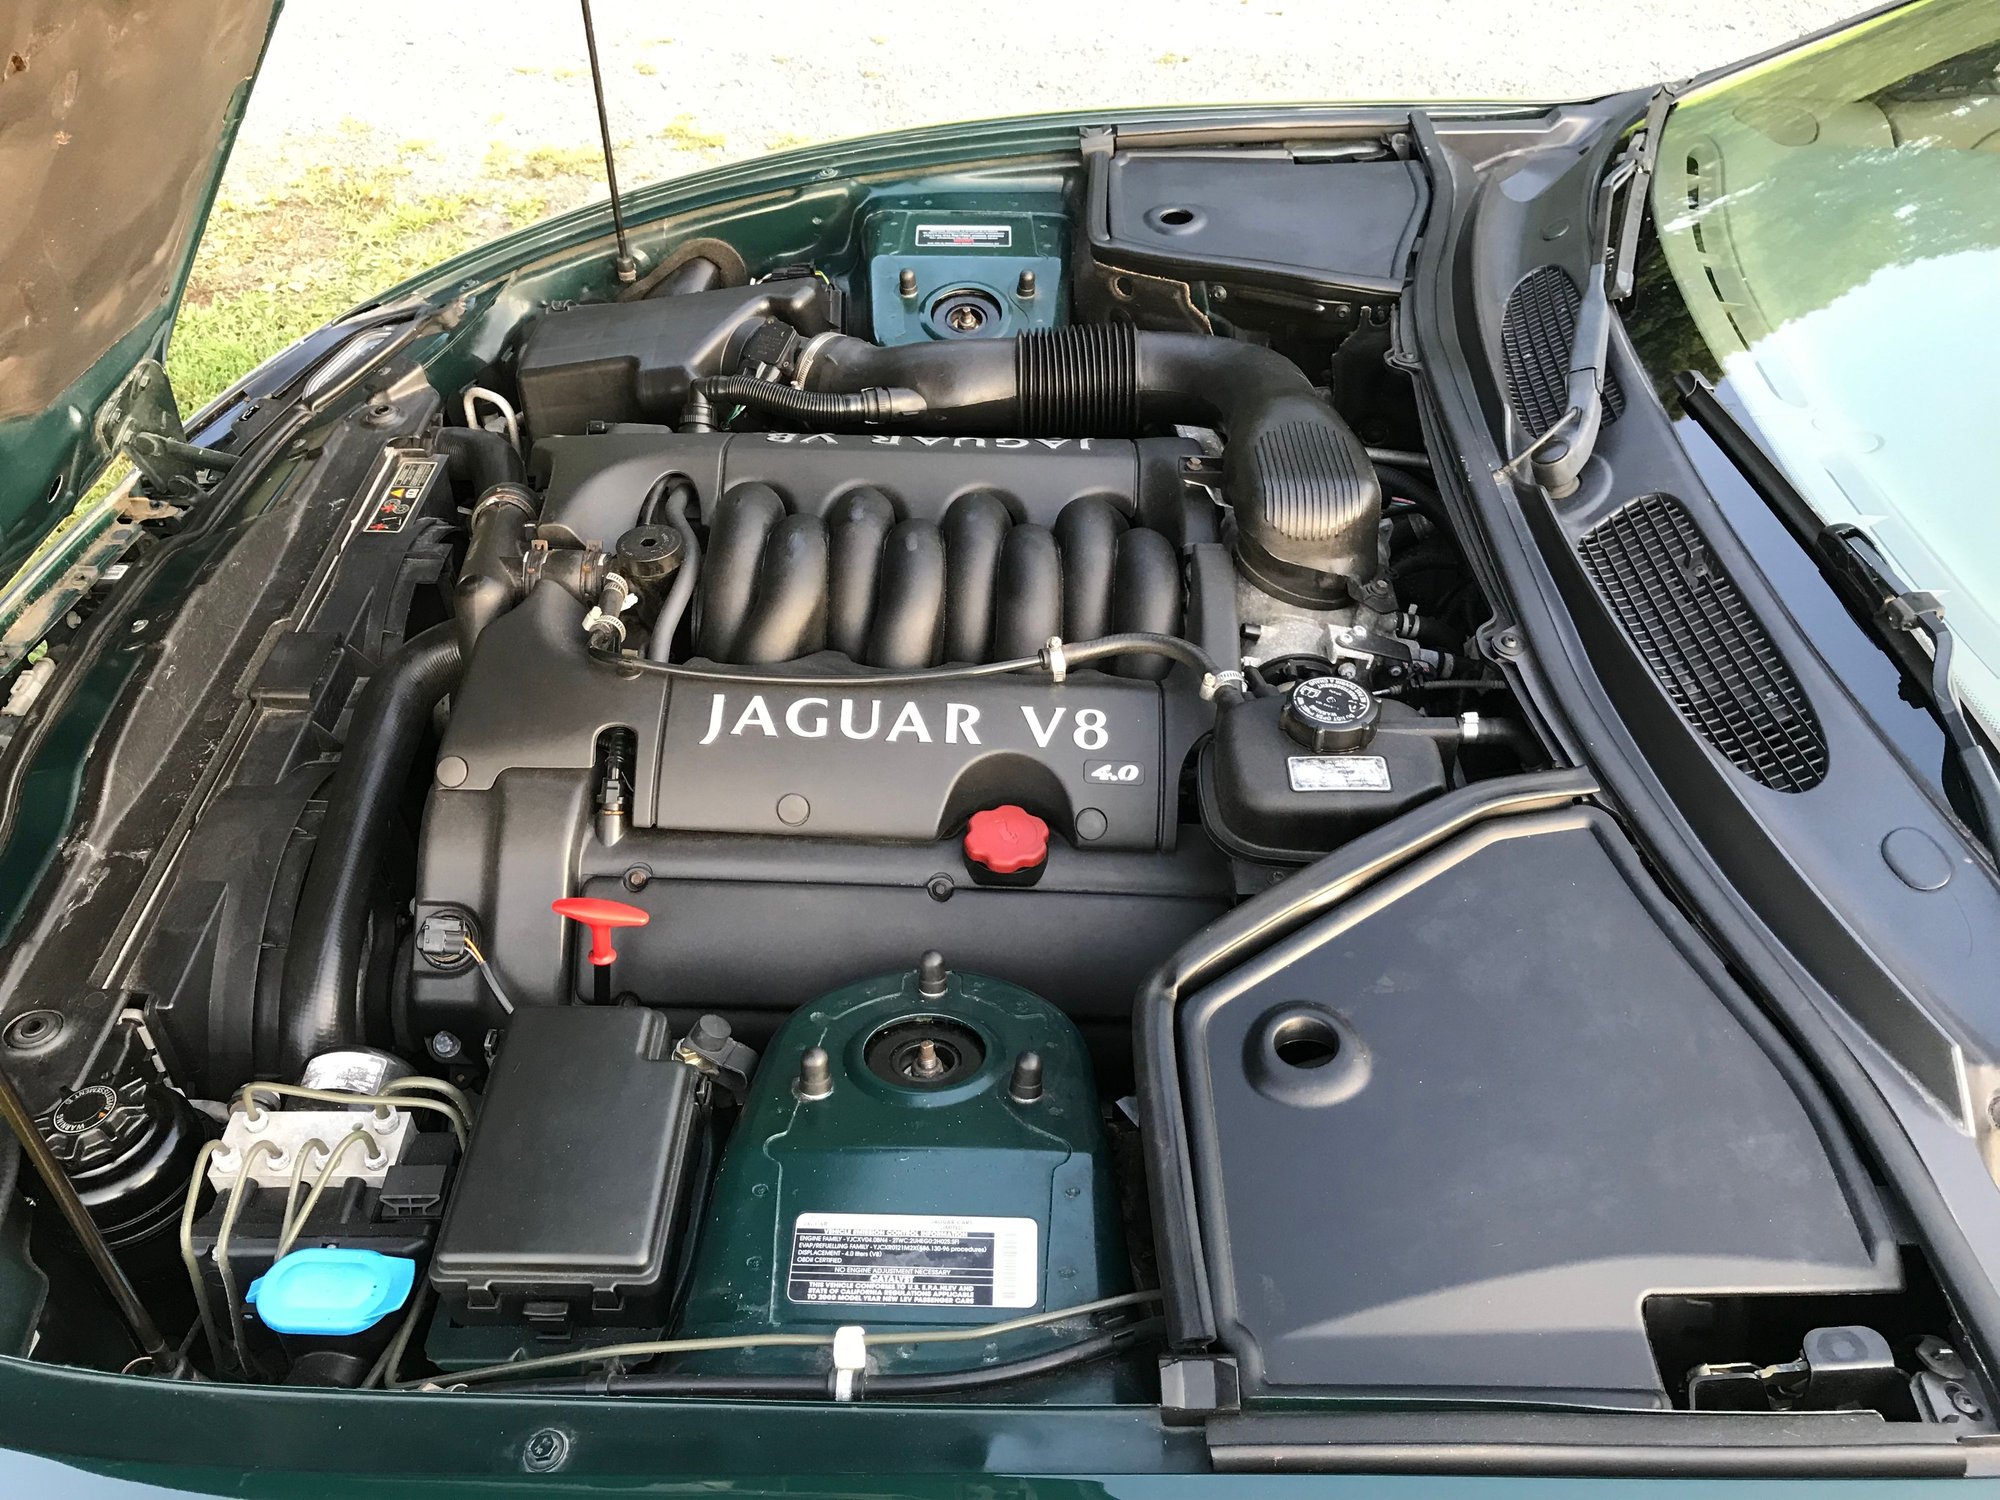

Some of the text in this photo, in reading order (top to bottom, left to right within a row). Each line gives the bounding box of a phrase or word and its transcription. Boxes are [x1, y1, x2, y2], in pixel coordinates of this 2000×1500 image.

[766, 432, 1095, 450] JAGUAR V8
[699, 693, 1110, 751] JAGUAR V8
[1090, 764, 1140, 782] 4.0
[56, 1113, 85, 1131] WARNING
[798, 1242, 848, 1250] EVAP/REFUELLING
[870, 1275, 914, 1283] CATALYST
[884, 1289, 932, 1297] REGULATIONS
[933, 1290, 974, 1298] APPLICABLE
